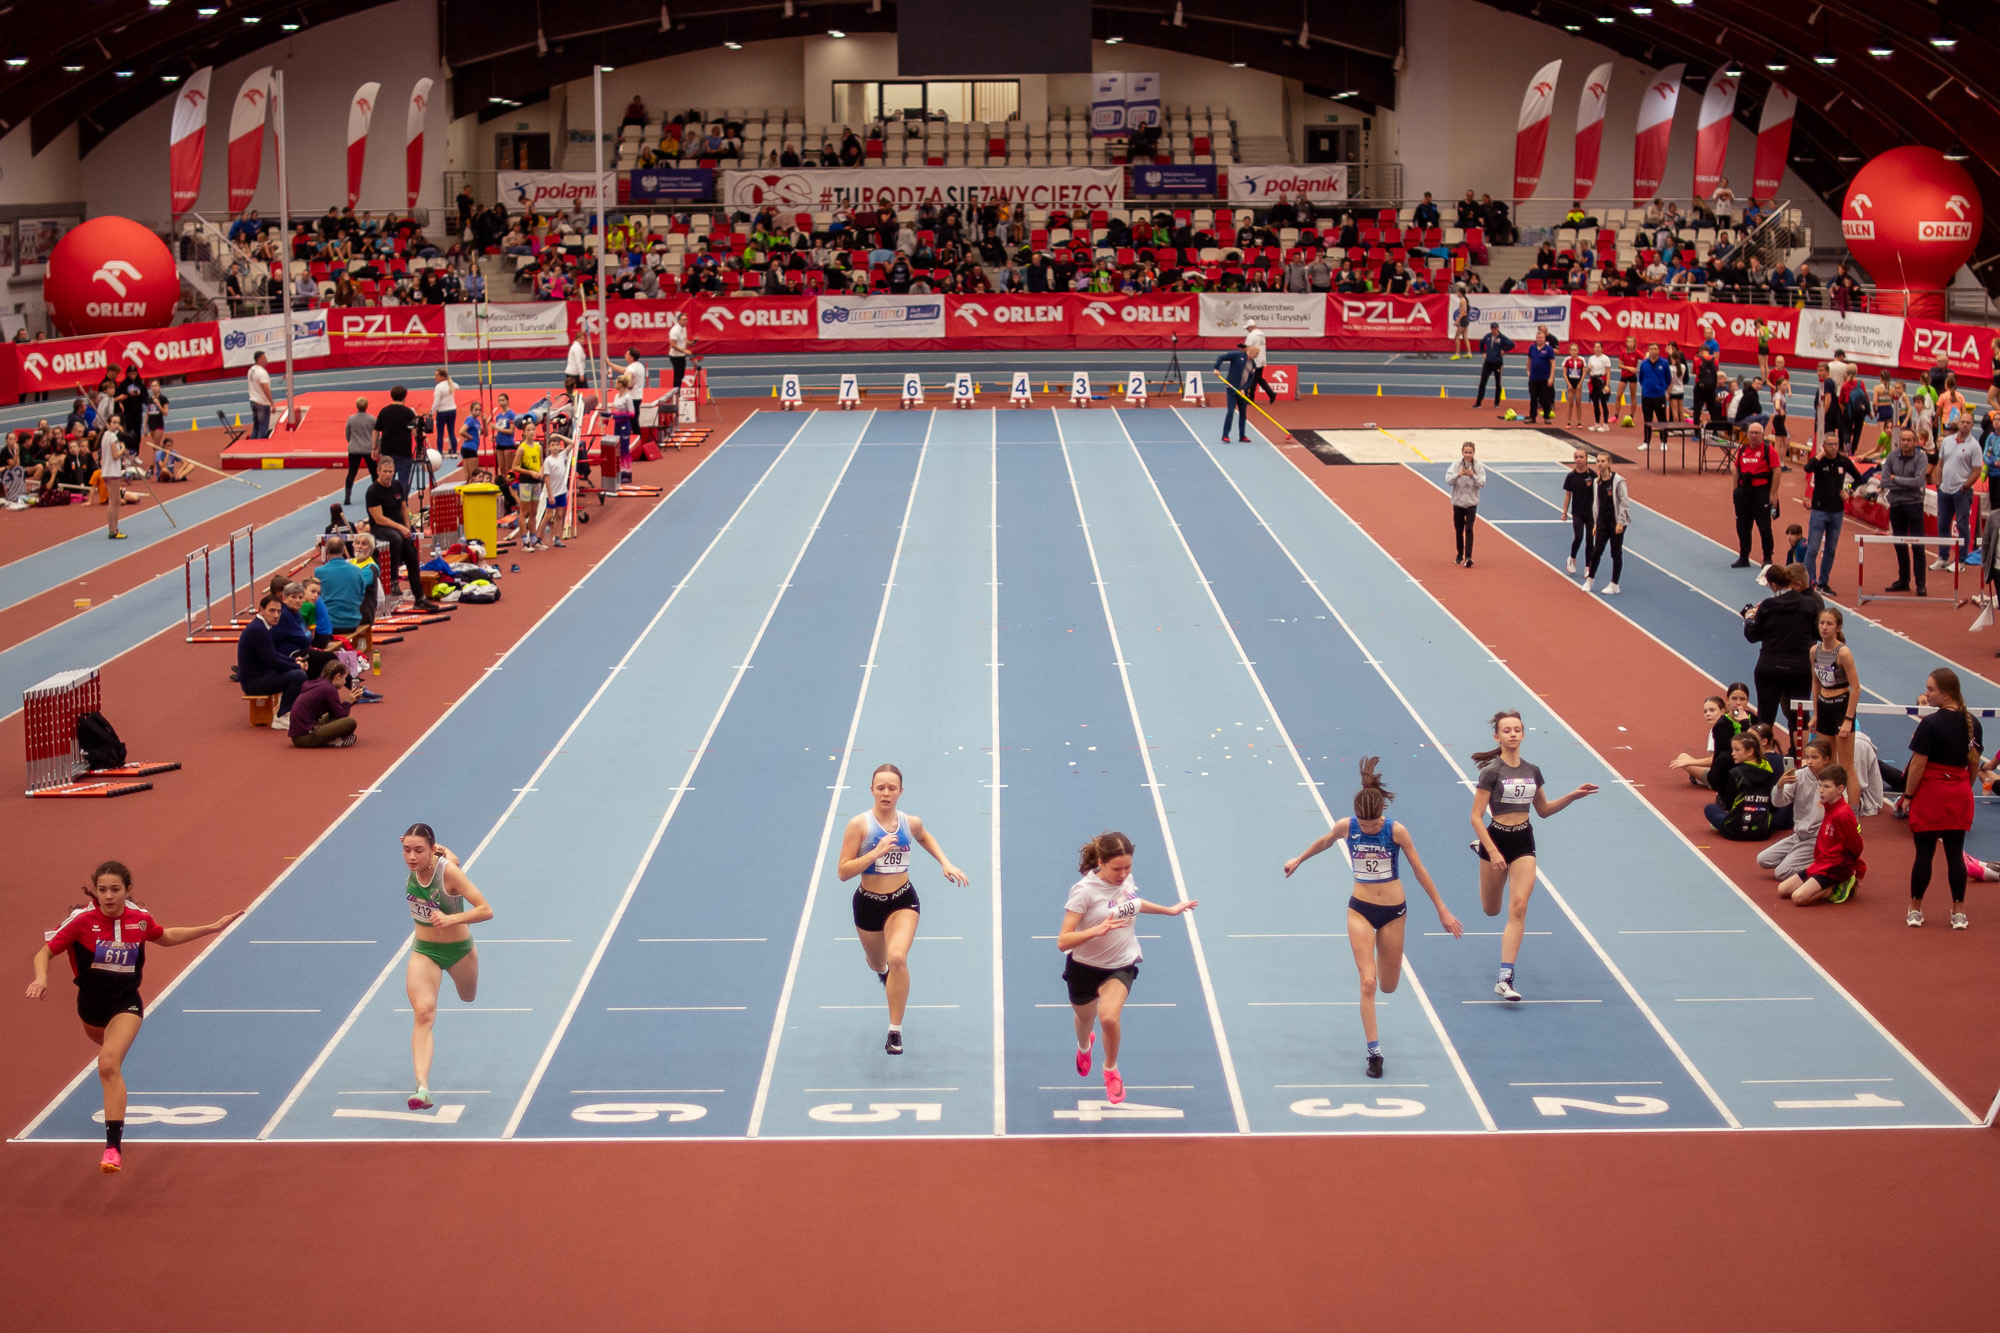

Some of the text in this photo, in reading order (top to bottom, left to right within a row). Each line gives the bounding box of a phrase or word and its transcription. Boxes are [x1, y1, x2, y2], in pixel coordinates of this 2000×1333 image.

[1264, 175, 1339, 196] polanik
[1923, 224, 1969, 238] ORLEN
[86, 301, 147, 318] ORLEN
[993, 305, 1064, 323] ORLEN
[1121, 305, 1190, 323] ORLEN
[1243, 303, 1295, 312] Ministerstwo
[1342, 300, 1432, 324] PZLA
[613, 311, 681, 330] ORLEN
[739, 308, 808, 326] ORLEN
[1276, 313, 1311, 323] Turystyki
[1616, 309, 1680, 332] ORLEN
[342, 313, 429, 339] PZLA
[1730, 317, 1792, 340] OREN
[1835, 321, 1881, 335] Ministerstwo
[154, 336, 214, 362] ORLEN
[1914, 327, 1980, 361] PZLA
[52, 349, 108, 373] ORLEN
[785, 380, 796, 397] 8
[843, 380, 854, 396] 7
[906, 380, 918, 397] 6
[958, 379, 969, 396] 5
[1015, 378, 1027, 395] 4
[1076, 378, 1086, 395] 3
[1131, 378, 1142, 395] 2
[1191, 377, 1198, 394] 1
[1514, 785, 1526, 797] 57
[1491, 821, 1528, 832] NIKE PRO
[1353, 844, 1387, 853] VECTRA
[884, 852, 902, 865] 269
[1365, 860, 1379, 873] 52
[863, 880, 911, 901] PRO NIKE
[414, 903, 432, 917] 212
[1117, 901, 1135, 918] 509
[105, 949, 129, 965] 611
[1053, 1099, 1185, 1120] 4
[1289, 1097, 1426, 1119] 3
[1532, 1095, 1670, 1116] 2
[1773, 1093, 1905, 1109] 1
[91, 1104, 227, 1125] 8
[332, 1104, 467, 1124] 7
[571, 1102, 708, 1124] 6
[808, 1102, 942, 1123] 5
